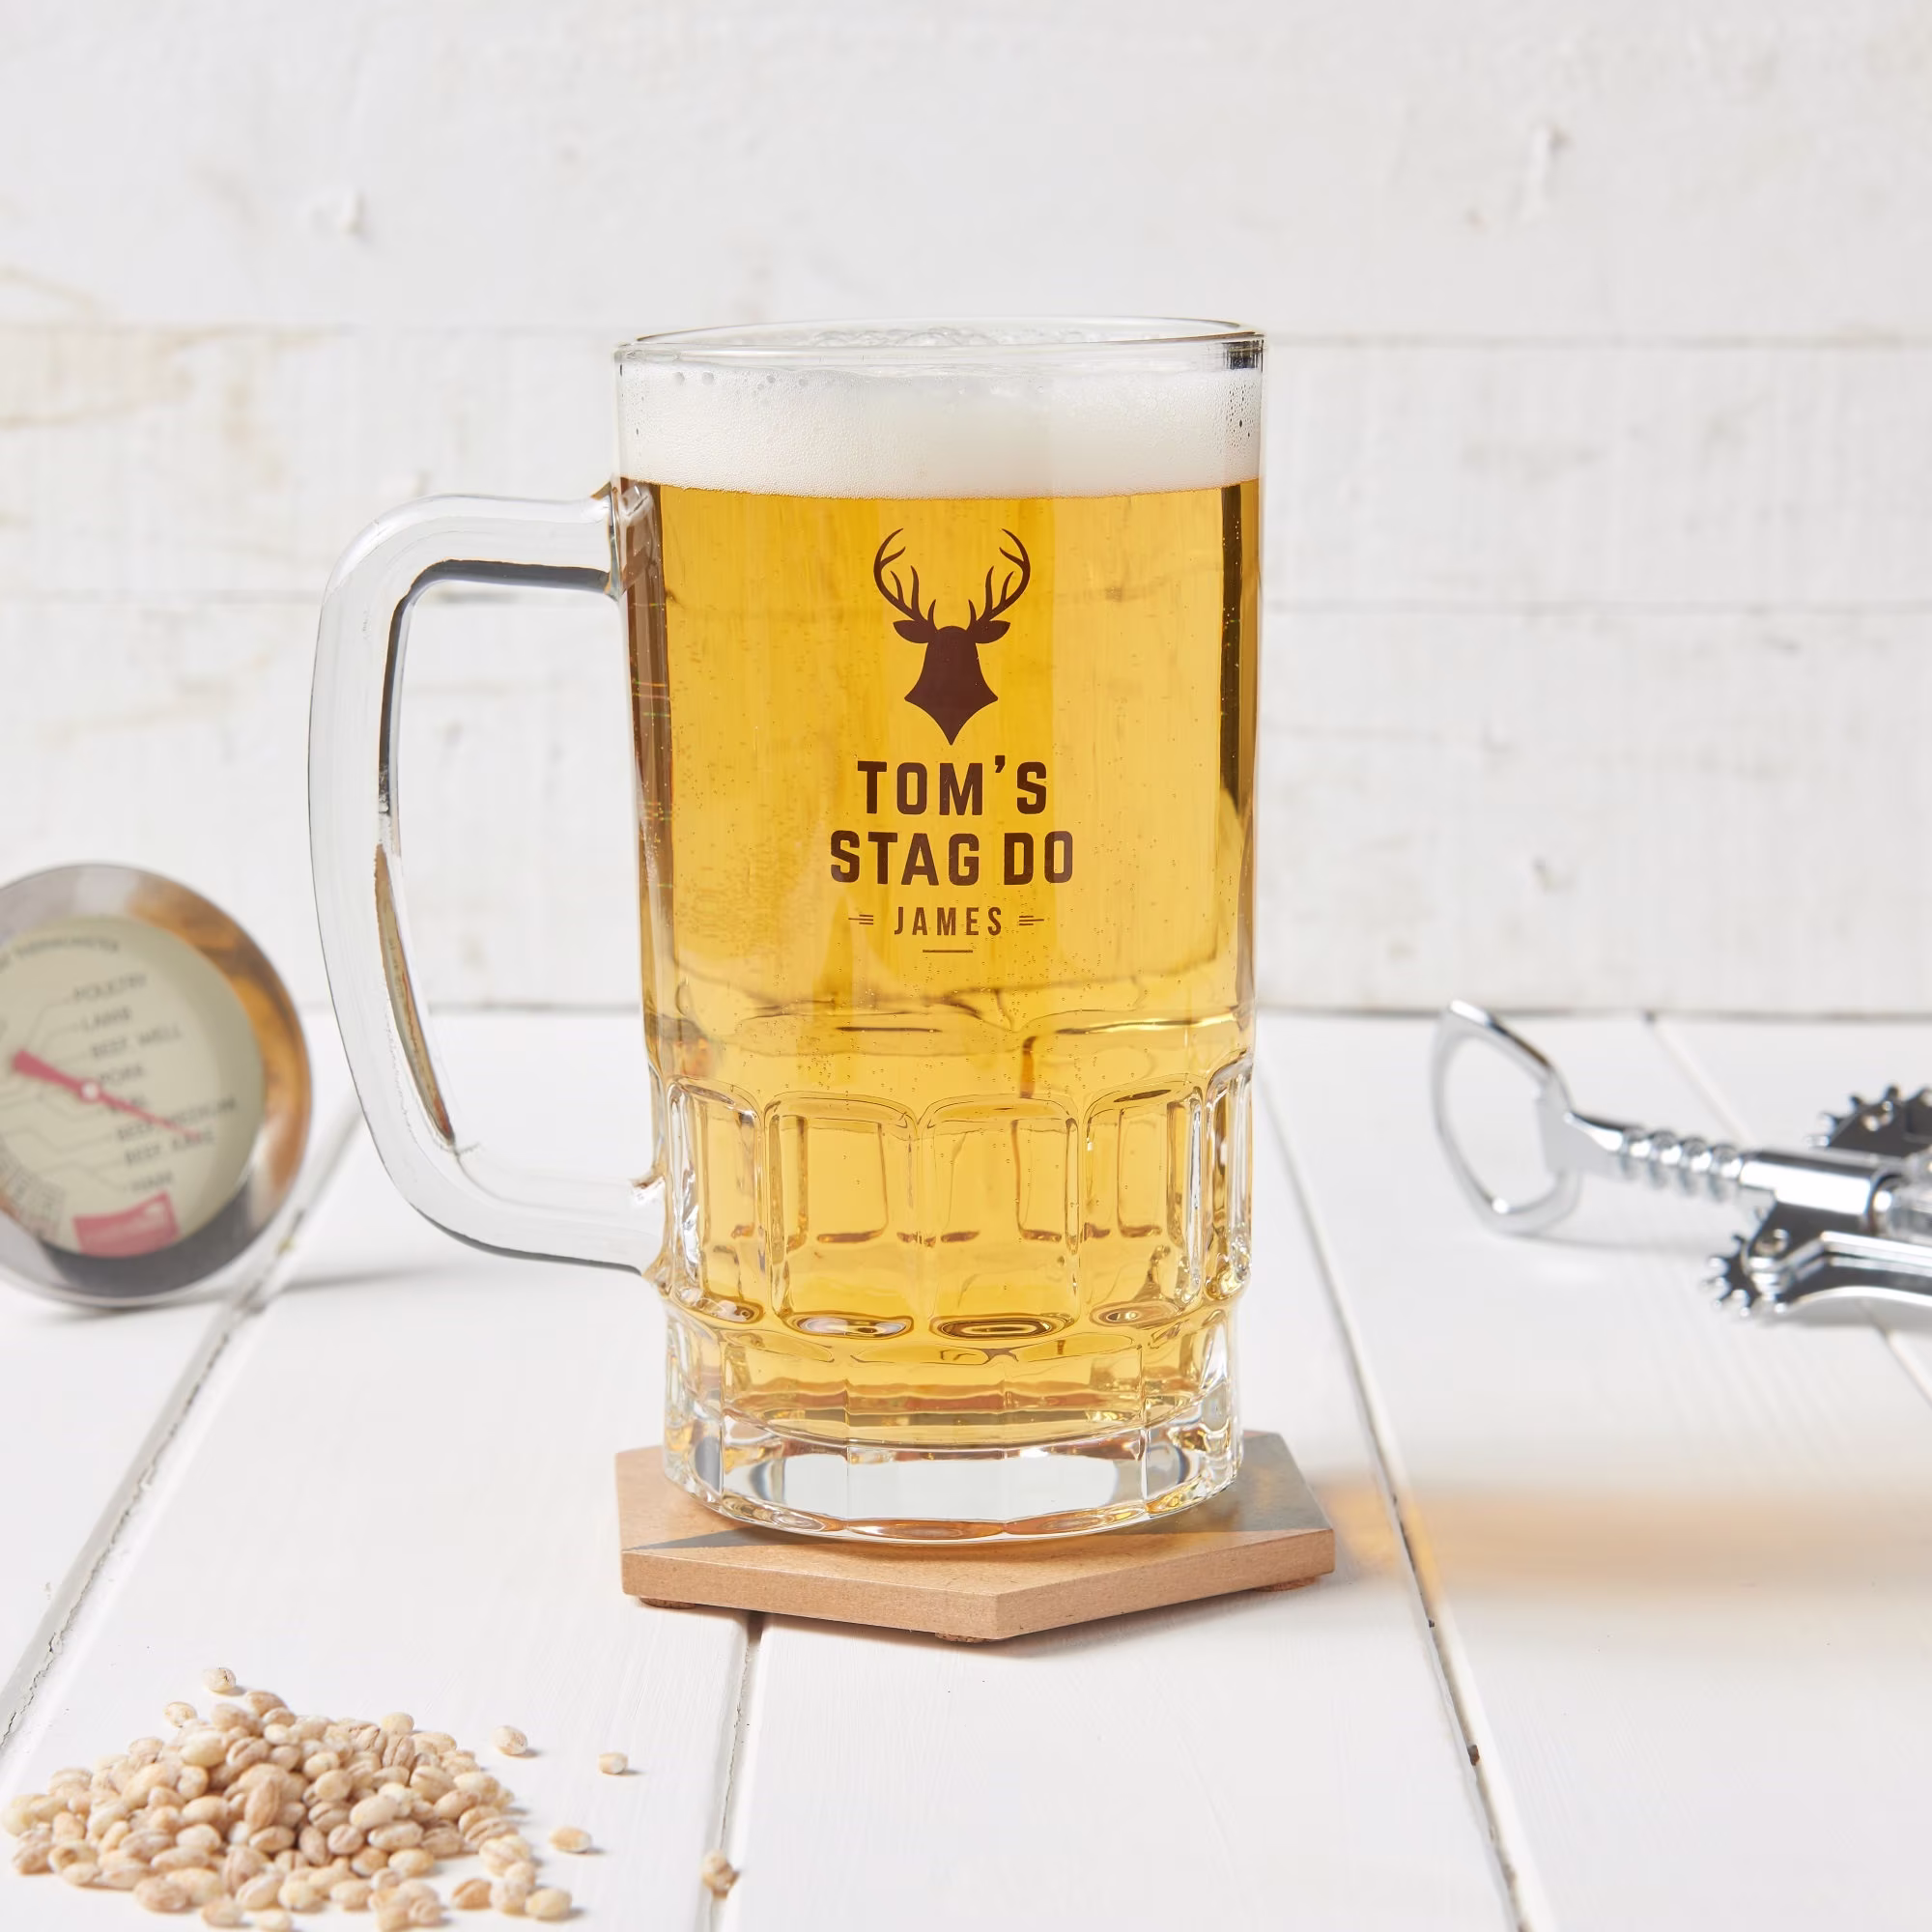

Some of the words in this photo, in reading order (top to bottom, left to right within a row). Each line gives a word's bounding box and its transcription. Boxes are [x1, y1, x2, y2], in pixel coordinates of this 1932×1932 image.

[857, 754, 1047, 815] TOM'S
[830, 830, 980, 886] STAG
[1004, 831, 1073, 886] DO
[894, 906, 1002, 936] JAMES
